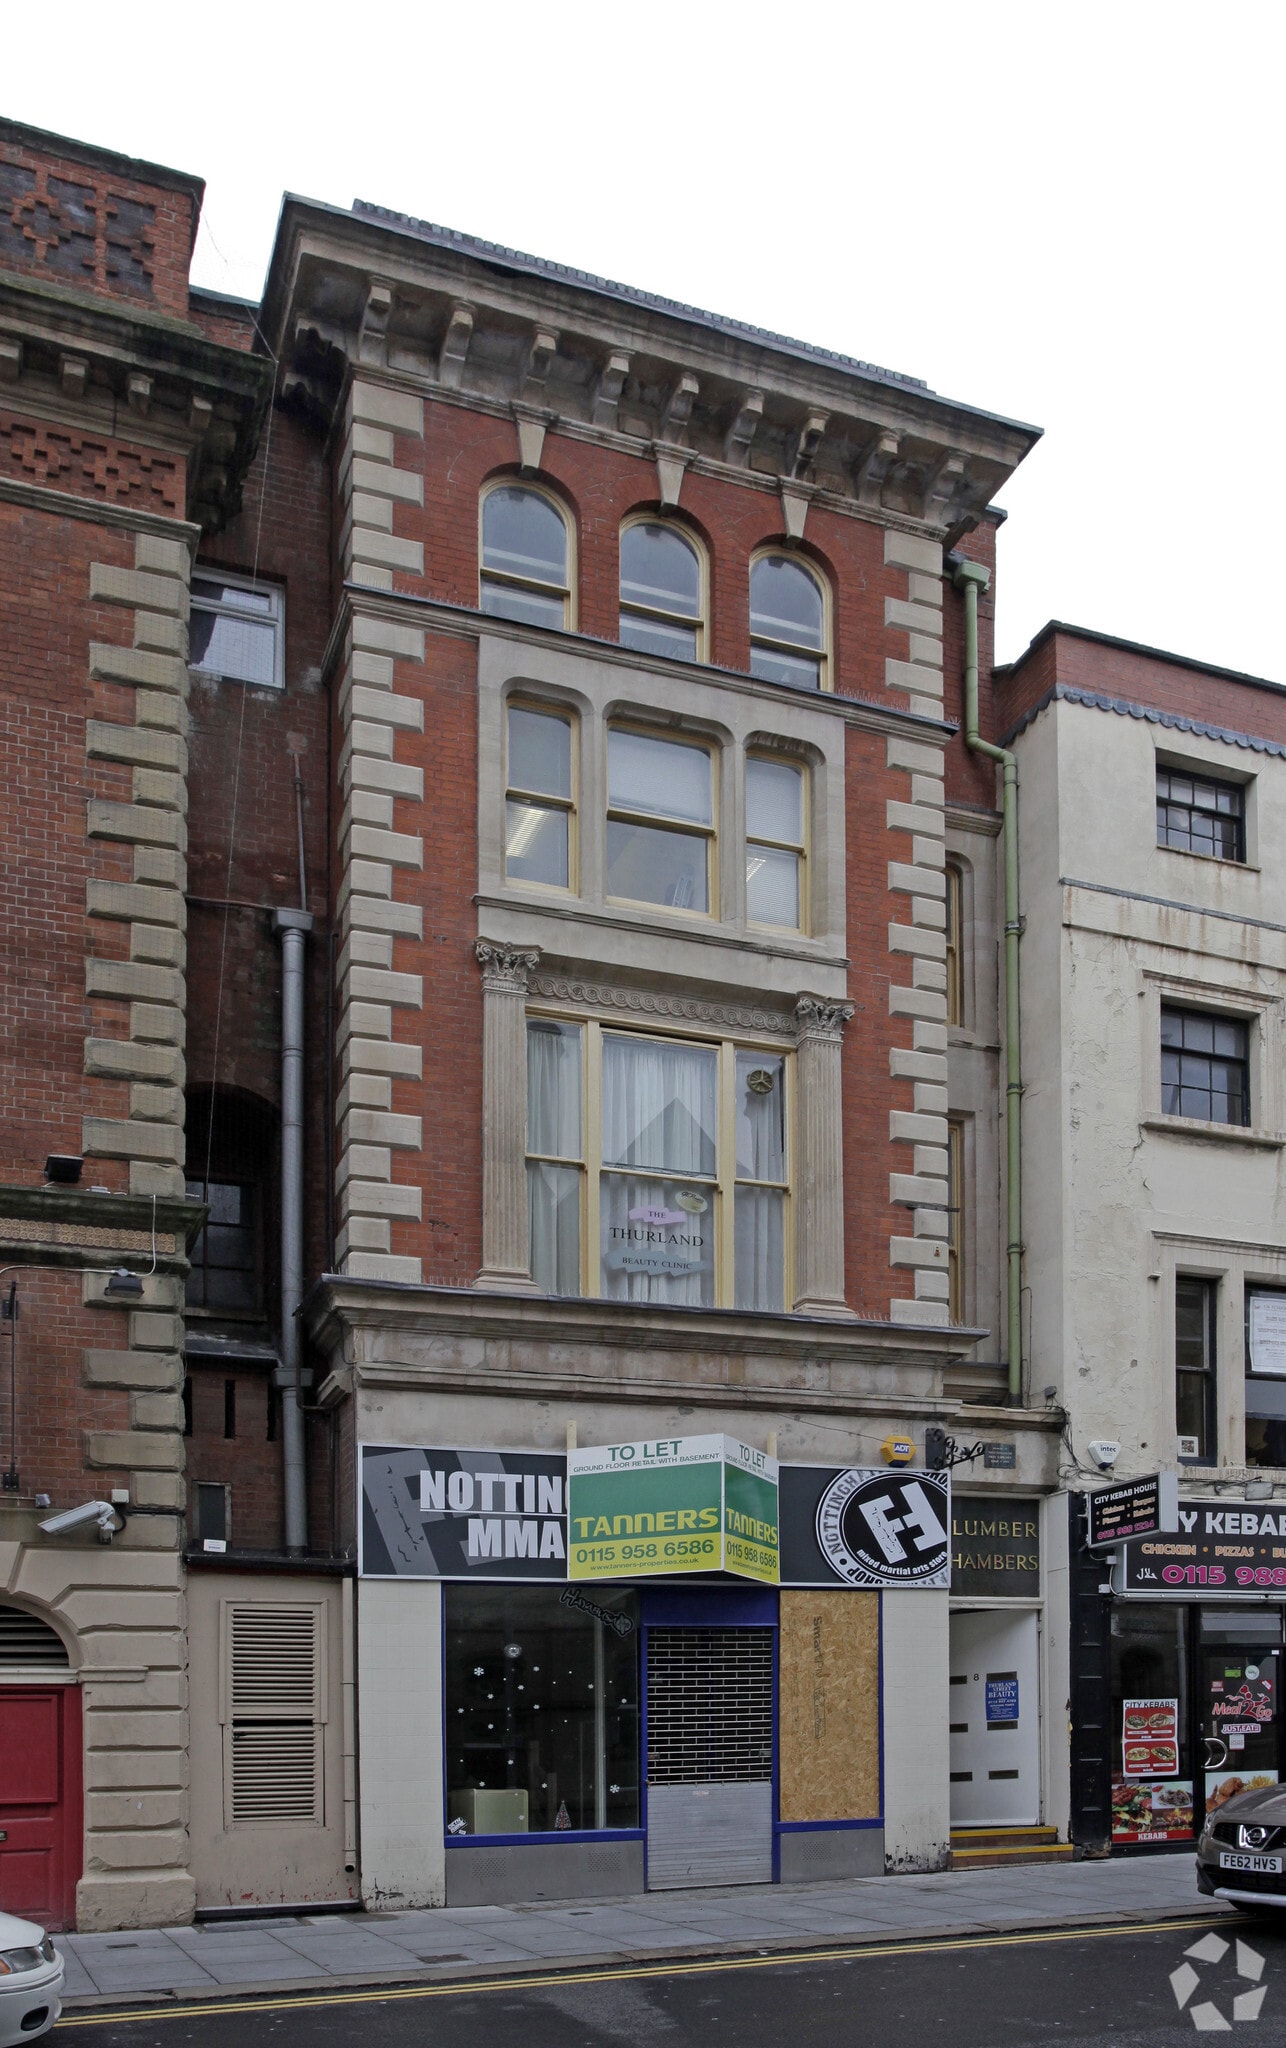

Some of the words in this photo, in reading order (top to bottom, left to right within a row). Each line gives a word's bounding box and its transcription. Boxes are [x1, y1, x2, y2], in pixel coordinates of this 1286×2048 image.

[647, 1210, 667, 1219] THE
[609, 1226, 704, 1247] THURLAND
[622, 1256, 659, 1267] BEAUTY
[661, 1260, 693, 1270] CLINIC
[607, 1445, 635, 1462] TO
[643, 1440, 683, 1458] LET
[739, 1444, 751, 1462] TO
[752, 1452, 766, 1470] LET
[894, 1444, 910, 1453] ADT
[573, 1464, 604, 1473] GROUND
[605, 1461, 630, 1470] FLOOR
[631, 1459, 656, 1467] RETAIL
[658, 1457, 678, 1465] WITH
[679, 1453, 720, 1463] BASEMENT
[419, 1469, 567, 1513] NOTTIN
[1094, 1494, 1109, 1505] CITY
[1110, 1488, 1133, 1501] KEBAB
[1133, 1481, 1157, 1495] HOUSE
[573, 1507, 719, 1538] TANNERS
[952, 1519, 1038, 1538] LUMBER
[467, 1518, 566, 1559] MMA
[576, 1547, 616, 1564] 0115
[621, 1543, 658, 1560] 958
[663, 1539, 714, 1557] 6586
[726, 1541, 743, 1559] 0115
[744, 1546, 758, 1563] 958
[759, 1549, 777, 1569] 6586
[1141, 1542, 1197, 1556] CHICKEN
[1214, 1545, 1255, 1558] PIZZAS
[1272, 1547, 1286, 1559] BU
[590, 1557, 699, 1572] www.tanners-properties.co.uk
[856, 1548, 881, 1568] mixed
[879, 1564, 911, 1576] martial
[912, 1565, 929, 1575] arts
[929, 1550, 947, 1567] store
[951, 1552, 1038, 1571] HAMBERS
[1161, 1564, 1227, 1585] 0115
[973, 1673, 980, 1682] 8
[988, 1691, 1017, 1699] BEAUTY
[1124, 1701, 1142, 1709] CITY
[1143, 1700, 1176, 1709] KEBABS
[1223, 1724, 1241, 1732] JUST
[1137, 1831, 1168, 1841] KEBABS
[1223, 1854, 1251, 1869] FE62
[1253, 1857, 1277, 1871] HVS
